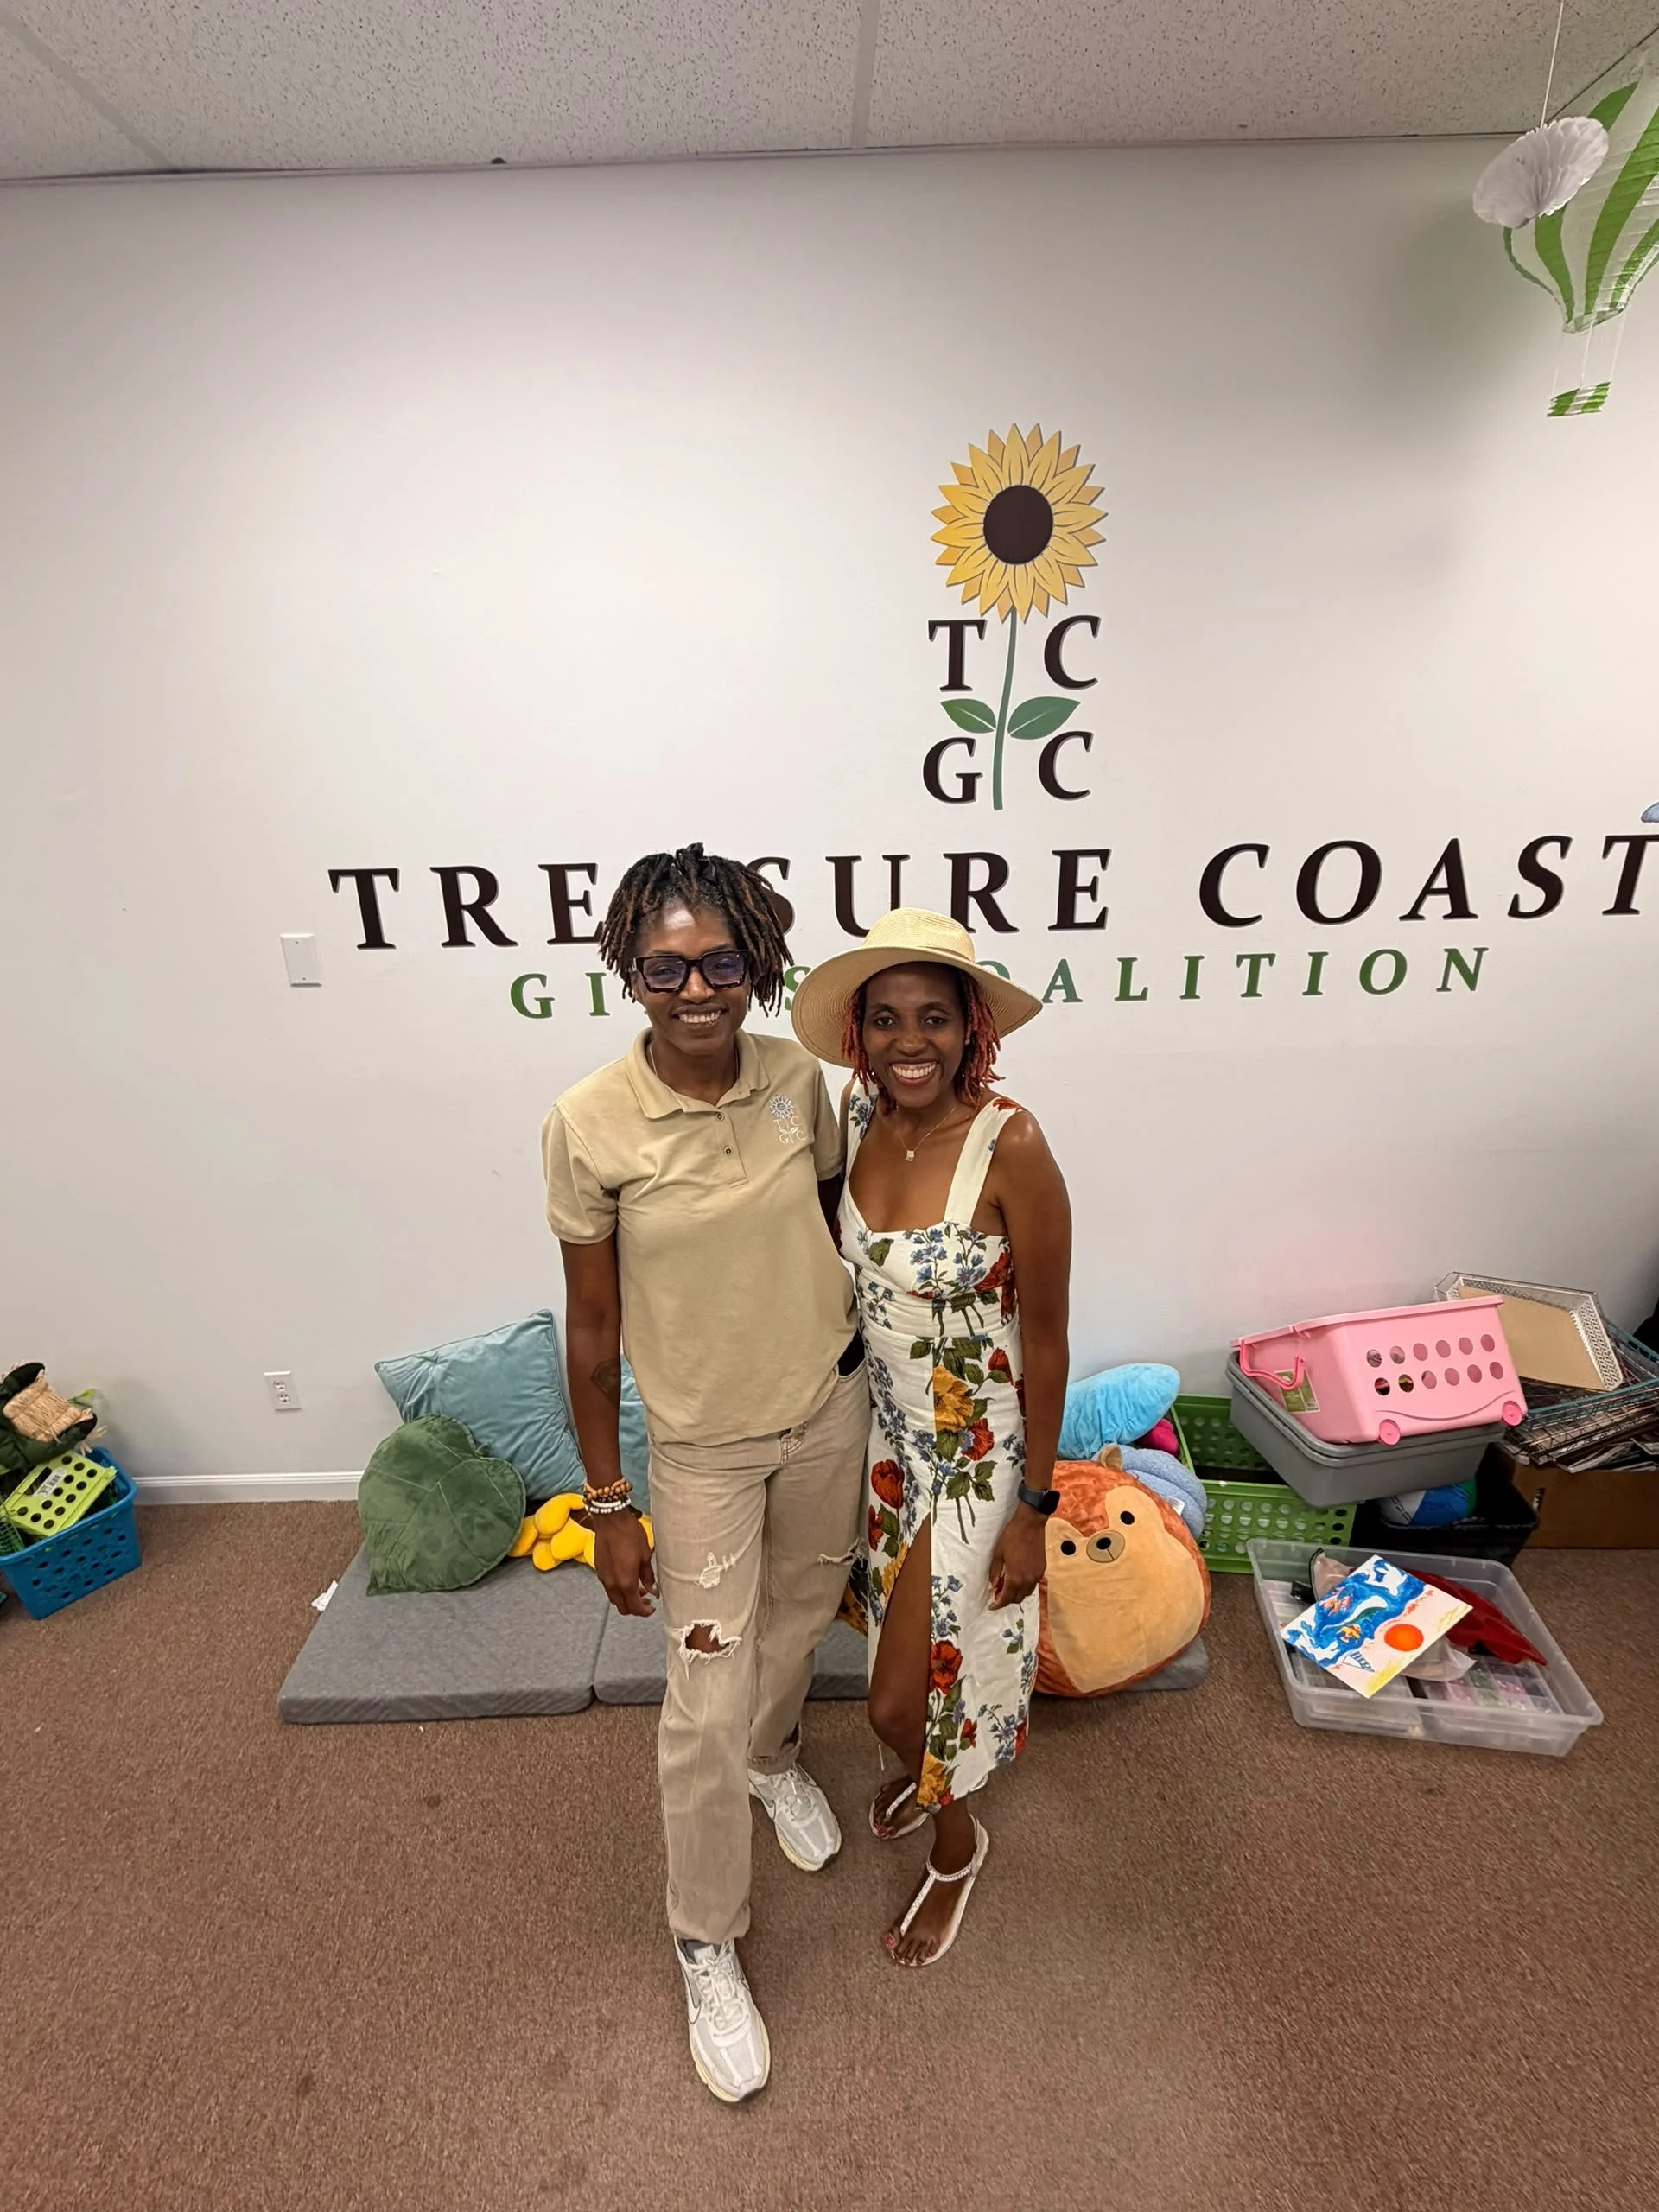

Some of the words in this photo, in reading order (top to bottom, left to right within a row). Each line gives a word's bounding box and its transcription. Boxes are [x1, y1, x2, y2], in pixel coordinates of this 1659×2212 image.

[928, 619, 987, 692] T
[1044, 614, 1102, 690] C
[923, 737, 983, 804] G
[1038, 730, 1094, 801] C
[327, 849, 1112, 950] TRESURE
[1198, 834, 1659, 928] COAST
[510, 965, 812, 1019] GIS
